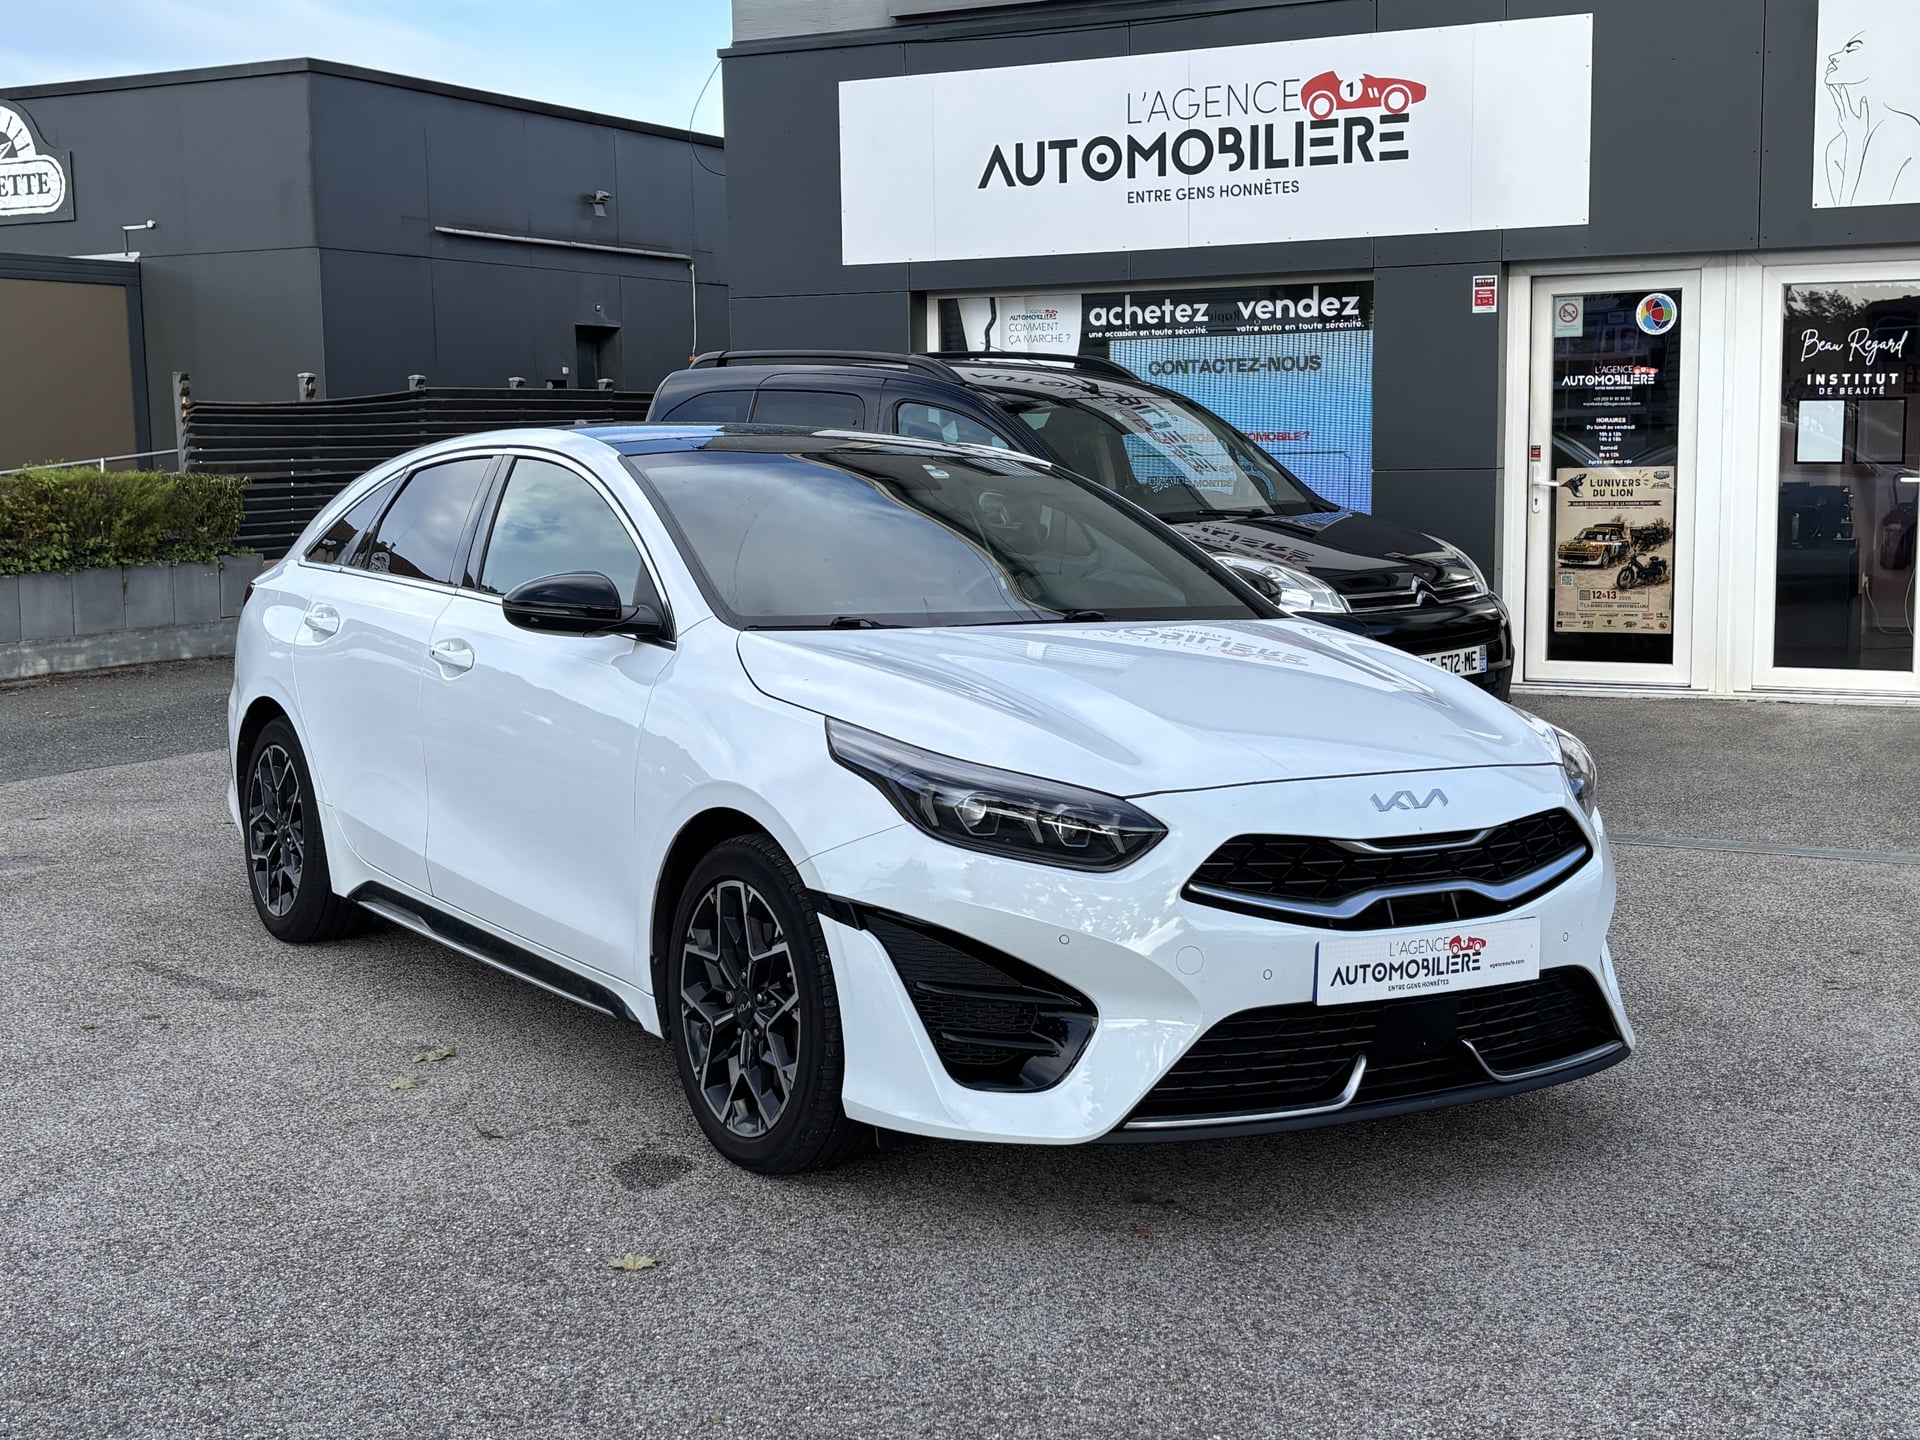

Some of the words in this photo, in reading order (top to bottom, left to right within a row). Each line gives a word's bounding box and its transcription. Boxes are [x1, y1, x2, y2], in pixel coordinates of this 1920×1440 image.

[1127, 79, 1300, 125] L'AGENCE
[978, 113, 1409, 189] AUTOMOBILIERE
[1127, 188, 1171, 204] ENTRE
[1175, 184, 1215, 200] GENS
[1219, 178, 1300, 197] HONNÊTES
[1089, 294, 1209, 326] achetez
[1237, 285, 1360, 320] vendez
[1008, 322, 1059, 333] COMMENT
[1104, 329, 1138, 338] occasion
[1151, 327, 1173, 335] toute
[1175, 325, 1208, 335] sécurité.
[1236, 325, 1259, 333] votre
[1299, 322, 1323, 330] toute
[1325, 318, 1364, 329] sérénité.
[1008, 334, 1021, 345] ÇA
[1024, 333, 1063, 343] MARCHE
[1800, 328, 1844, 362] Beau
[1848, 327, 1909, 366] Regard
[1147, 354, 1322, 377] CONTACTEZ-NOUS
[1595, 365, 1634, 374] L'AGENCE
[1561, 374, 1655, 387] AUTOMOBILIERE
[1807, 373, 1899, 386] INSTITUT
[1818, 387, 1833, 395] DE
[1840, 386, 1885, 395] BEAUTÉ
[1593, 489, 1606, 497] DU
[1611, 489, 1634, 497] LION
[1369, 788, 1448, 812] KIA
[1389, 936, 1450, 957] L'AGENCE
[1330, 951, 1481, 987] AUTOMOBILIERE
[1388, 983, 1406, 992] ENTRE
